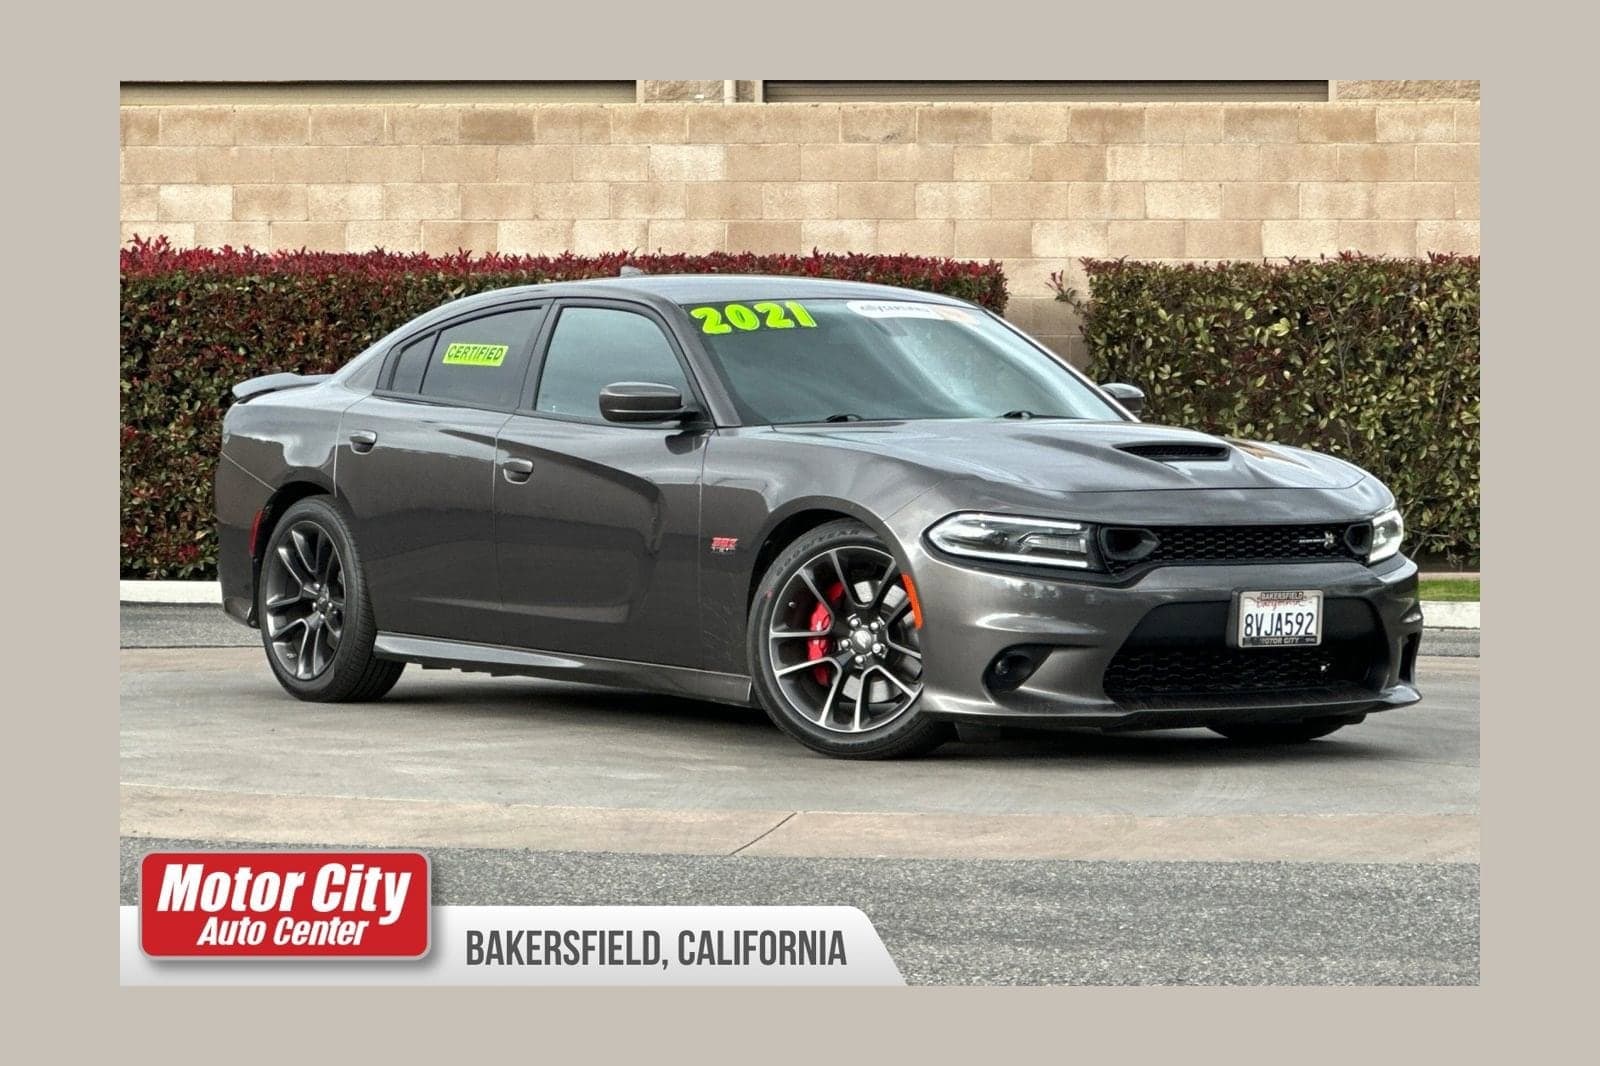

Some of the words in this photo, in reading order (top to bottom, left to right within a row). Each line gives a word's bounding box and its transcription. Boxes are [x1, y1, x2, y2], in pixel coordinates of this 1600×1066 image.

[690, 301, 818, 335] 2021
[447, 345, 504, 360] CERTIFIED
[1261, 591, 1304, 601] BAKERSFIELD
[1244, 612, 1314, 637] 8VJA592
